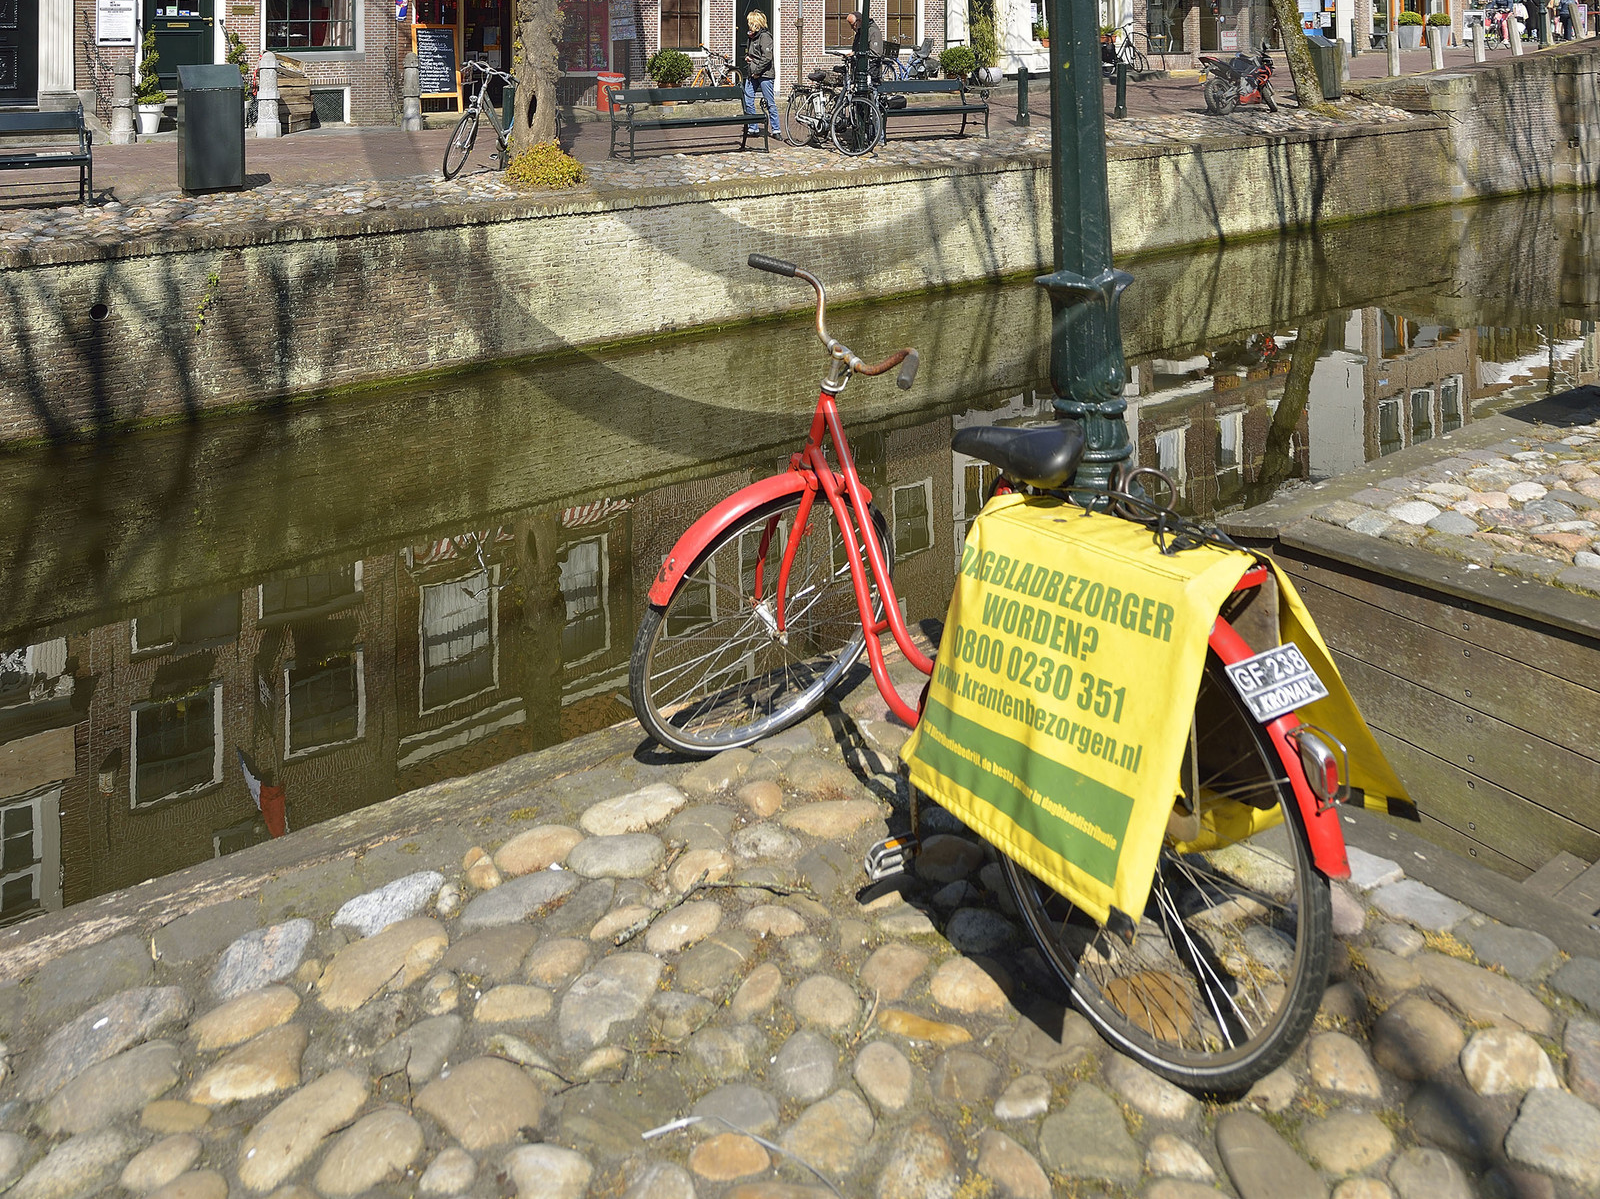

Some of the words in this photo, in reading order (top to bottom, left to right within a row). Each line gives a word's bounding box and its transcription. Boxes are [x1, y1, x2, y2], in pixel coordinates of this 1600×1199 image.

[960, 544, 1175, 642] DAGBLADBEZORGER
[981, 592, 1099, 662] WORDEN?
[953, 624, 1004, 674] 0800
[1006, 645, 1073, 701] 0230
[1076, 671, 1127, 724] 351
[1234, 662, 1264, 692] GF
[1265, 649, 1307, 681] 238
[1259, 678, 1313, 714] KRONAN
[937, 662, 1143, 774] www.krantenbezorgen.nl
[992, 761, 1014, 784] beste
[1040, 795, 1118, 851] dagbladdistributie
